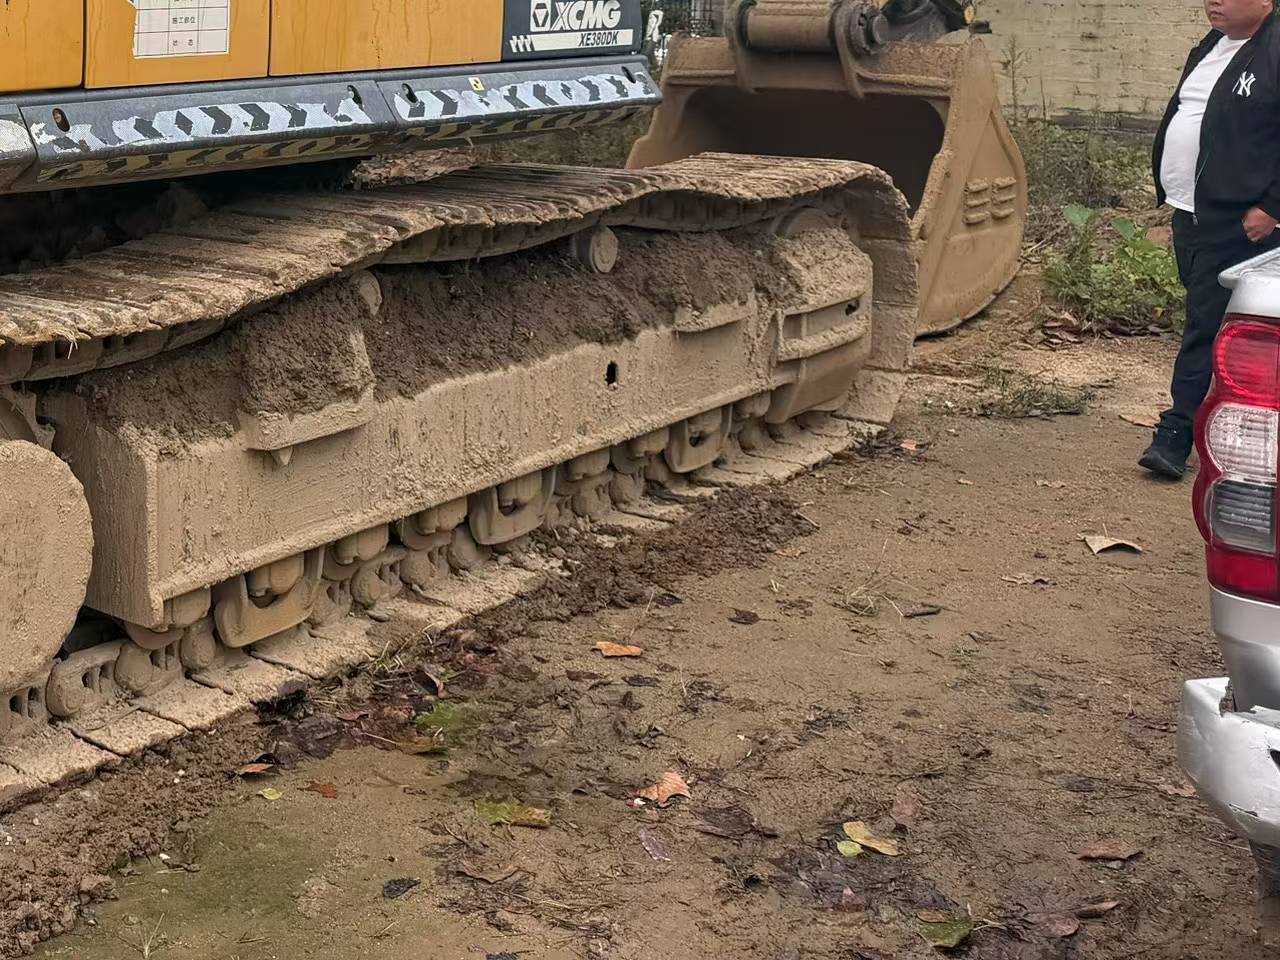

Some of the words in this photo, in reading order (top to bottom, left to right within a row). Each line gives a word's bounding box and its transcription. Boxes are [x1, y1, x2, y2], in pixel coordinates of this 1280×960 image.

[551, 0, 621, 31] XCMG
[578, 31, 619, 47] XE380DK
[1232, 71, 1256, 97] NY
